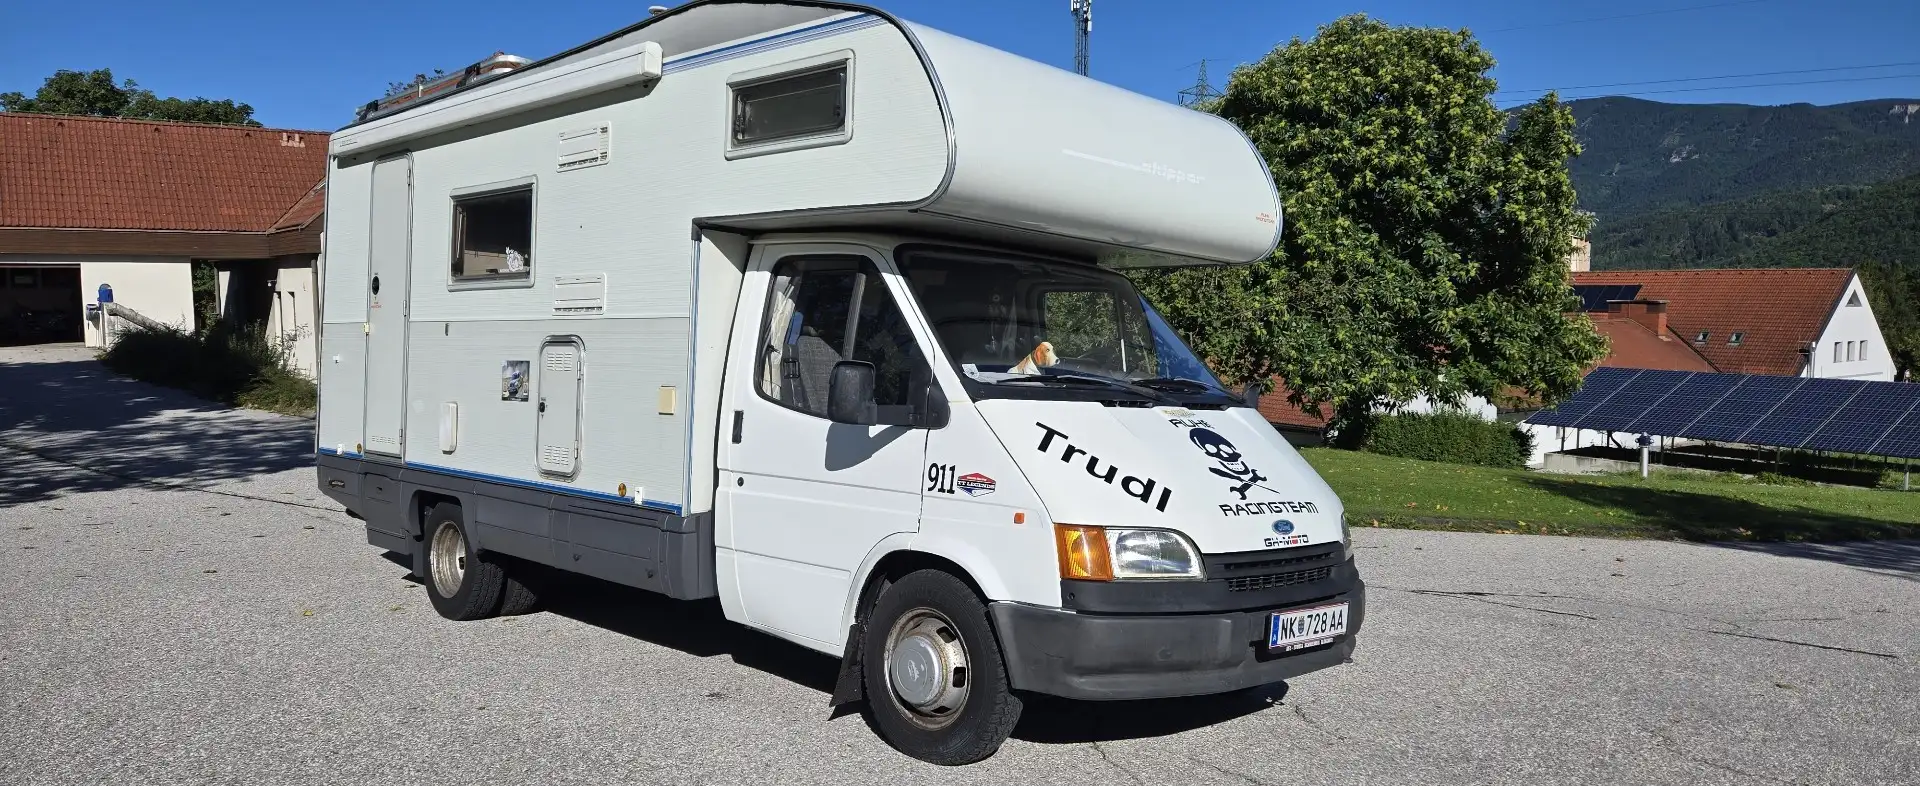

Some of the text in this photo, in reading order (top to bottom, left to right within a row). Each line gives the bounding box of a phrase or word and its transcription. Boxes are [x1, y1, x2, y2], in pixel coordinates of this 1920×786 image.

[927, 462, 956, 494] 911
[1035, 421, 1172, 513] Trudl
[1218, 501, 1319, 516] RACINGTEAM
[1281, 616, 1298, 640] NK
[1306, 611, 1328, 636] 728
[1329, 608, 1344, 631] AA
